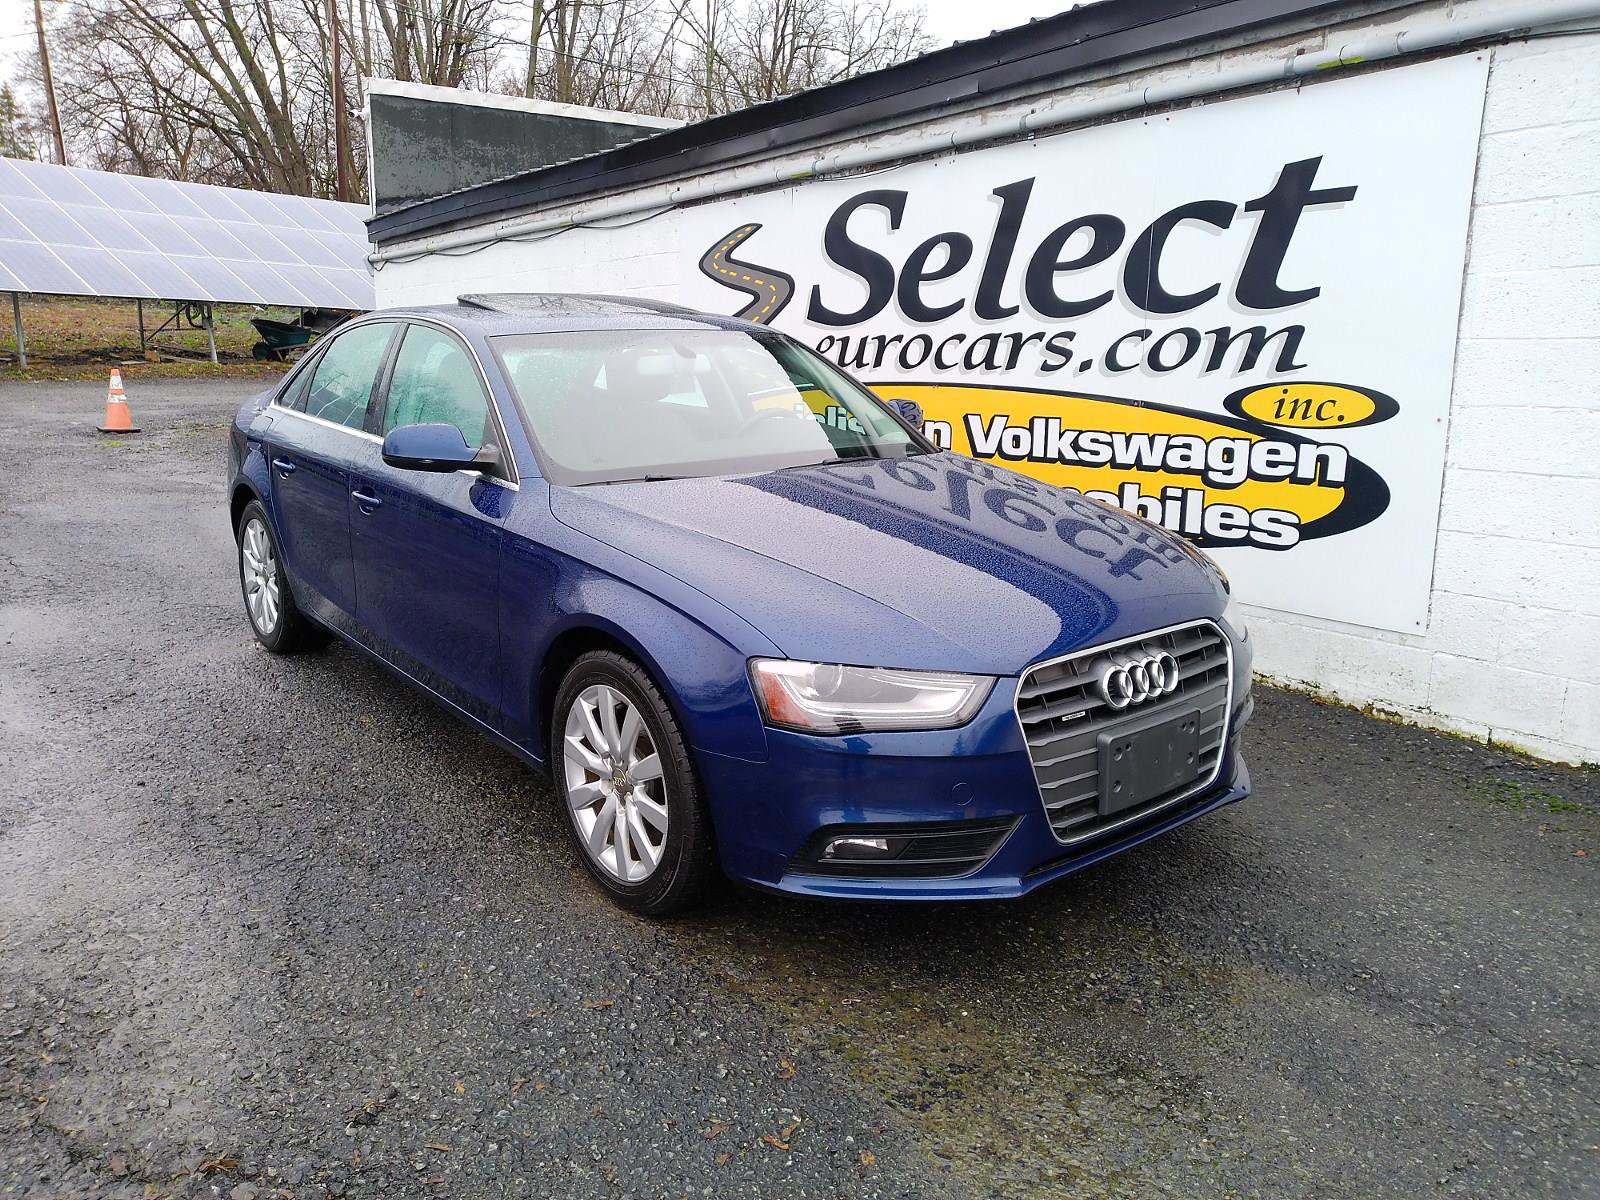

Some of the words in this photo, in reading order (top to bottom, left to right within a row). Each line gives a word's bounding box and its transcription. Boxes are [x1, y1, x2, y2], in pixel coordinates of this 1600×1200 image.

[806, 155, 1358, 327] Select
[1273, 389, 1345, 421] inc.
[965, 413, 1349, 485] Volkswagen
